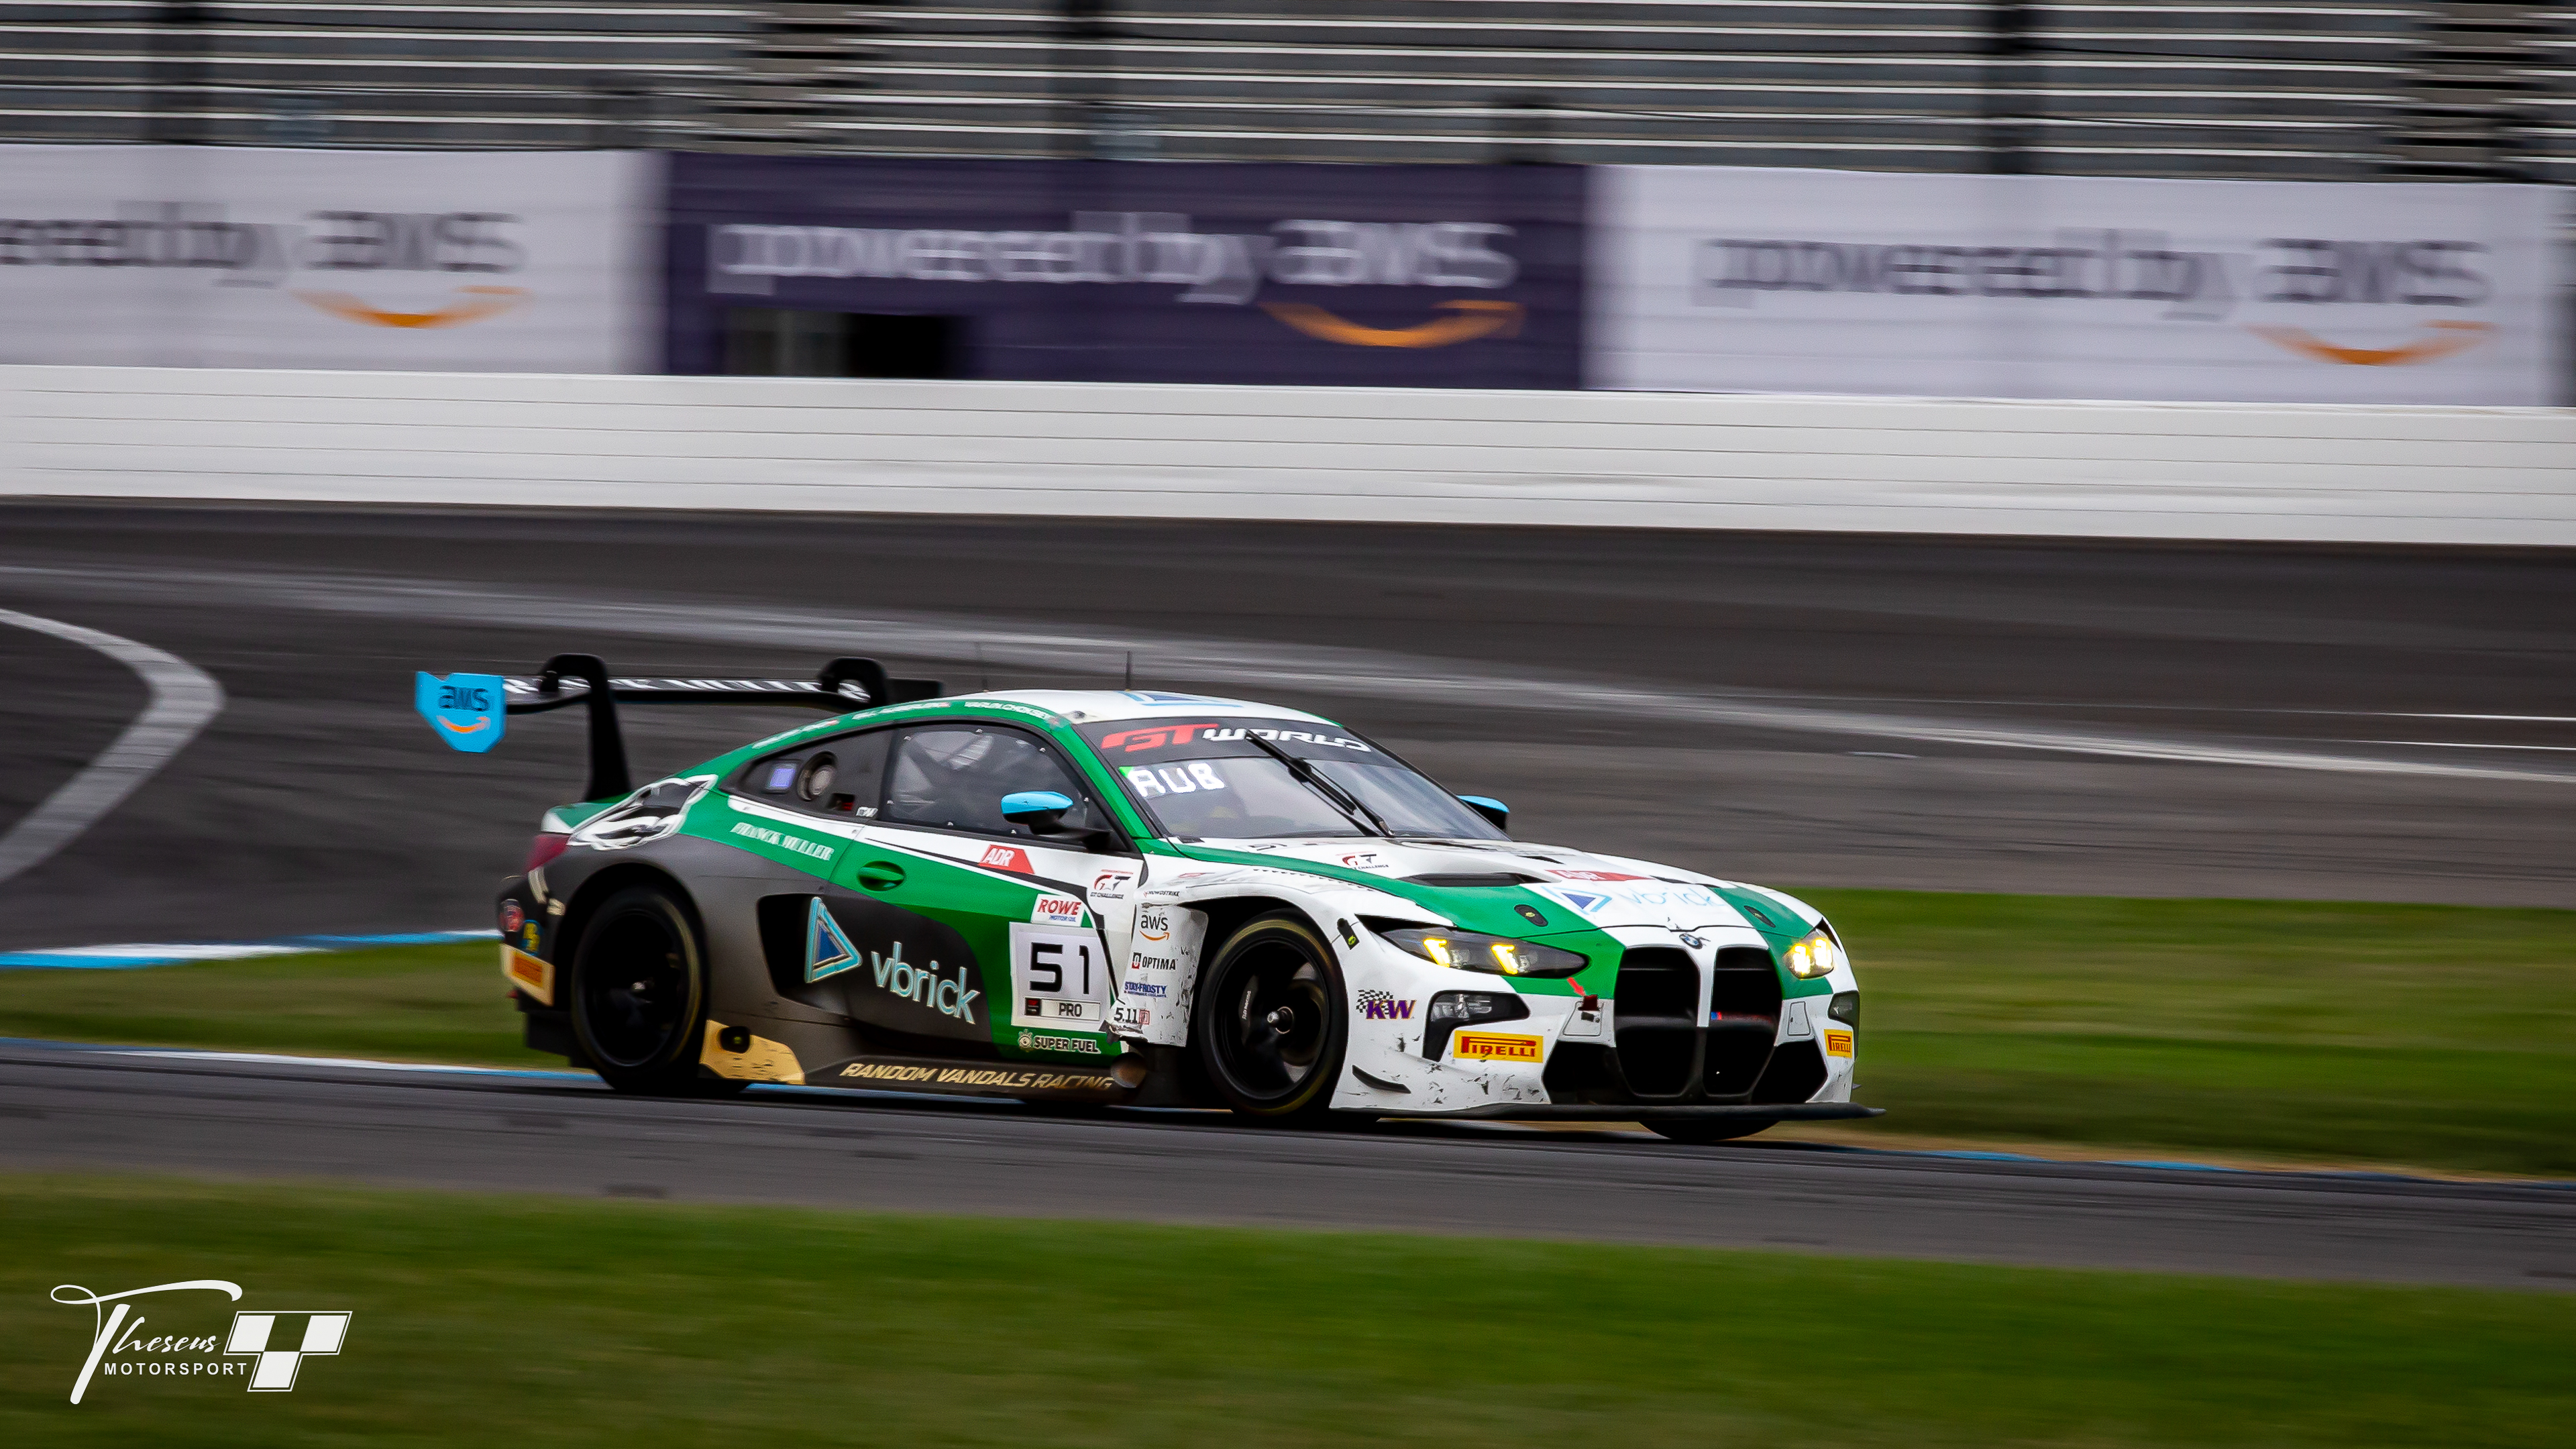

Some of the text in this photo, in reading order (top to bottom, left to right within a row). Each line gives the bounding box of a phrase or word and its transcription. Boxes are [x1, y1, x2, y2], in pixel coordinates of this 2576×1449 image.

[303, 209, 526, 274] aws
[1269, 219, 1519, 288] aws
[2254, 237, 2491, 306] aws
[438, 685, 492, 712] aws
[1128, 762, 1226, 798] AUB
[981, 848, 1015, 867] ADR
[1037, 899, 1081, 915] ROWE
[1140, 914, 1169, 930] aws
[1029, 942, 1089, 994] 51
[1142, 956, 1176, 970] OPTIMA
[871, 941, 980, 1024] vbrick
[1059, 1002, 1083, 1018] PRO
[1114, 1007, 1138, 1024] 5.11
[1366, 999, 1417, 1020] KW
[1034, 1036, 1100, 1053] SUPER FUEL
[1461, 1036, 1536, 1057] PIRELLI
[839, 1063, 1115, 1090] RANDOM VANDALS RACING
